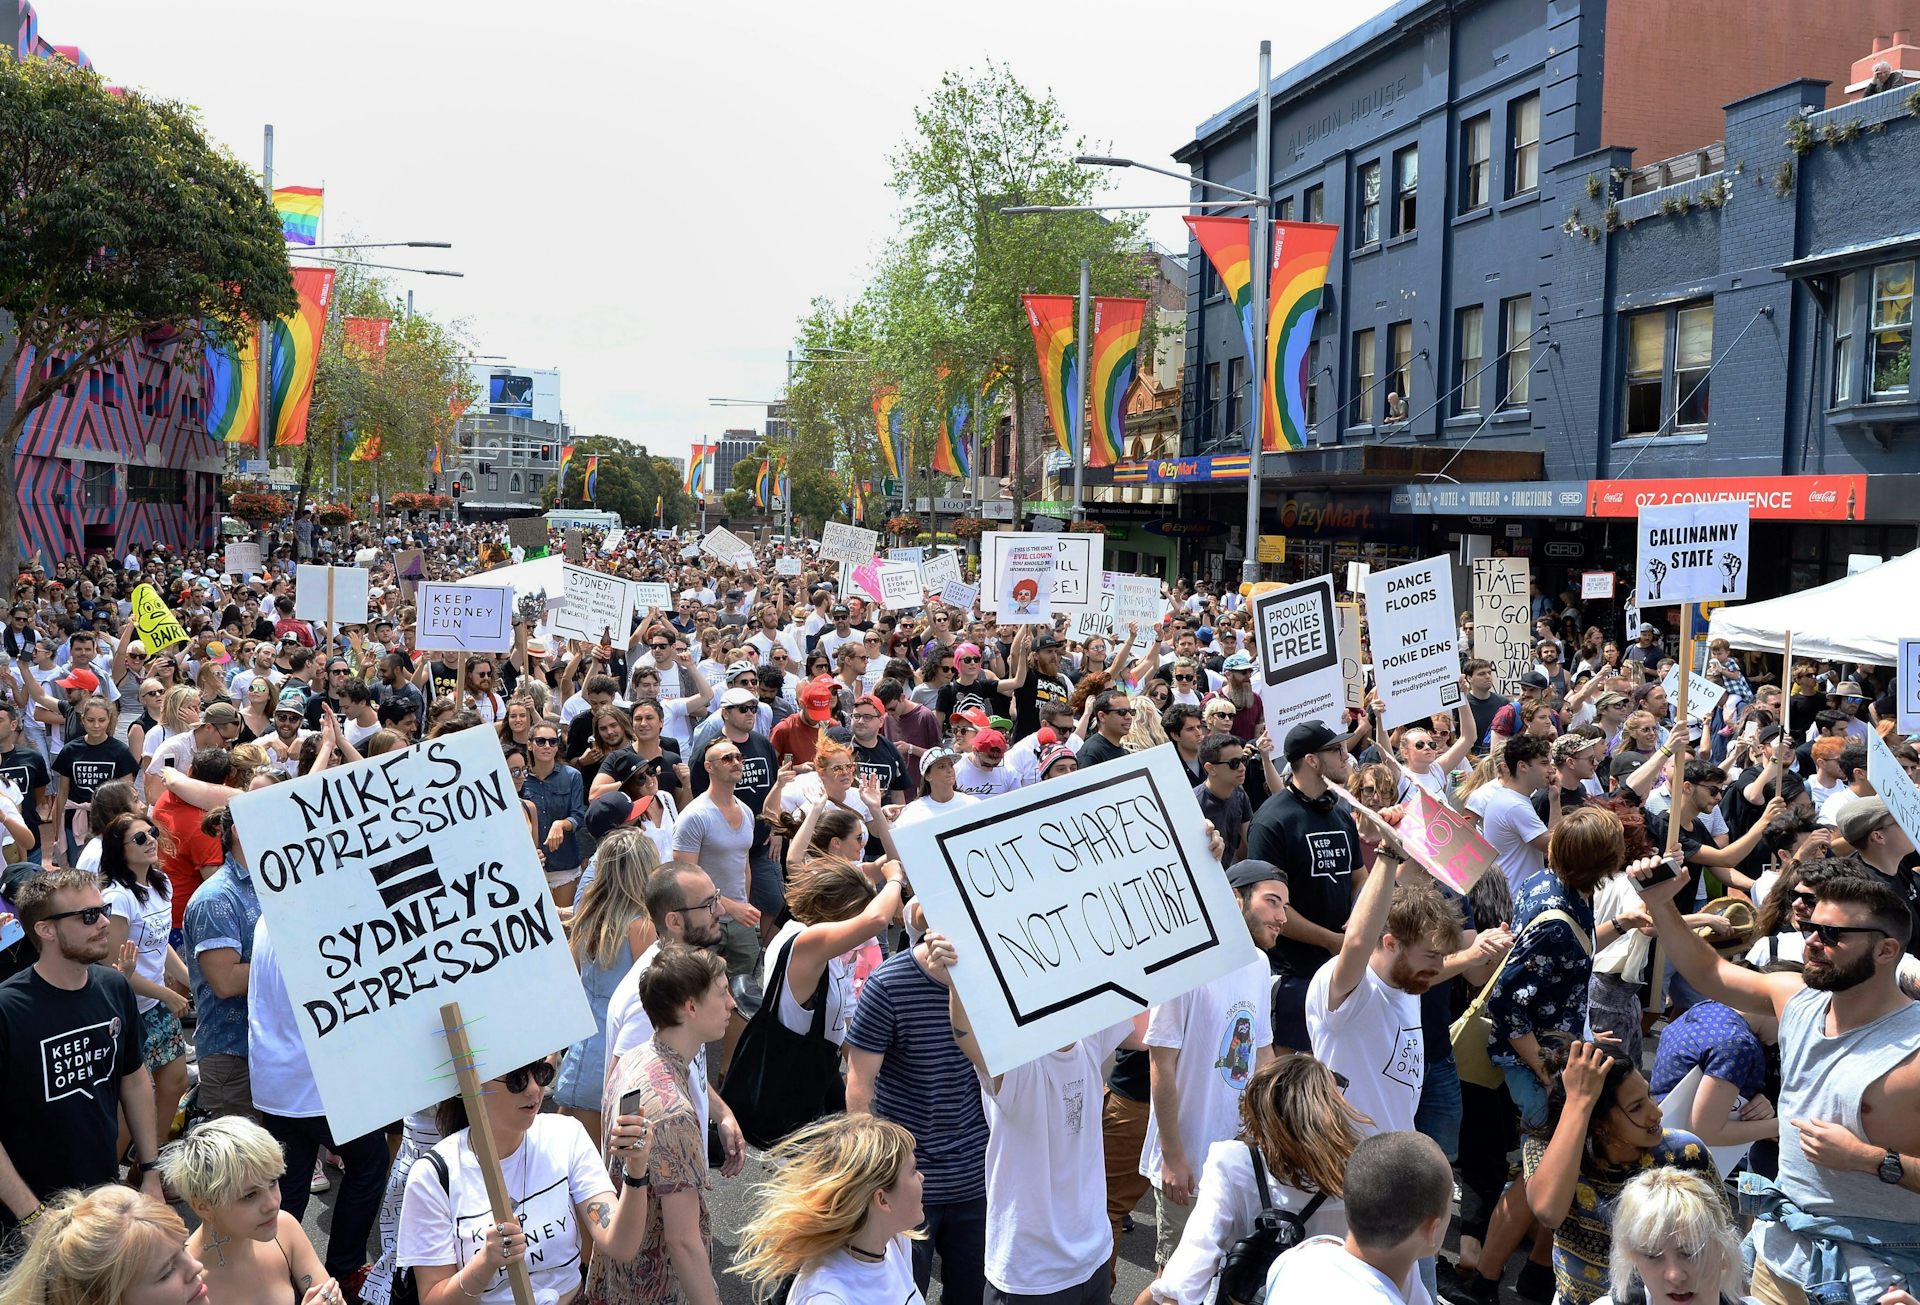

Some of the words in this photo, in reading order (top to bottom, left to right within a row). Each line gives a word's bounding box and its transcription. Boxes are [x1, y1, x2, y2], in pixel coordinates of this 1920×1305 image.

[1288, 108, 1341, 156] ALBION
[1351, 74, 1406, 125] HOUSE
[1165, 462, 1197, 480] EzyMart
[1439, 492, 1458, 506] HOTEL
[1469, 492, 1499, 506] WINEBAR
[1511, 491, 1552, 506] FUNCTIONS
[1659, 493, 1668, 505] 2
[1297, 502, 1372, 533] EzyMart
[824, 533, 874, 553] PRO-LOCKOUT
[826, 523, 848, 536] WHERE
[850, 529, 862, 539] ARE
[864, 531, 876, 541] THE
[1649, 523, 1738, 547] CALLINANNY
[822, 546, 872, 564] MARCHERS?
[1671, 549, 1714, 569] STATE
[571, 573, 612, 593] SYDNEY!
[1124, 584, 1144, 594] INVITED
[1145, 586, 1157, 596] MY
[1387, 571, 1432, 593] DANCE
[1474, 571, 1526, 594] TIME
[434, 594, 472, 604] KEEP
[565, 592, 590, 605] SPERANCE,
[947, 593, 961, 601] OPEN
[949, 589, 970, 600] SYDNEY
[1385, 589, 1437, 613] FLOORS
[1475, 594, 1501, 609] TO
[433, 606, 493, 617] SYDNEY
[1269, 598, 1317, 623] PROUDLY
[1501, 605, 1529, 624] GO
[432, 618, 462, 628] FUN
[1082, 612, 1114, 635] BAIR
[1270, 612, 1320, 640] POKIES
[1401, 628, 1428, 647] NOT
[1476, 625, 1508, 644] TO
[1272, 629, 1322, 664] FREE
[1382, 650, 1418, 670] POKIE
[1420, 640, 1452, 659] DENS
[1504, 641, 1530, 660] BED
[1392, 665, 1447, 687] #keepsydneyopen
[1490, 660, 1530, 679] ASINO
[1391, 674, 1451, 697] #proudlypokiesfree
[1674, 671, 1702, 691] Rht
[1703, 687, 1715, 698] to
[1277, 701, 1334, 726] #proudlypokiesfree
[1278, 692, 1332, 715] #keepsydneyopen
[743, 768, 766, 778] YDNEY
[290, 742, 463, 832] MIKE'S
[259, 769, 508, 892] OPPRESSION
[966, 835, 1035, 898] CUT
[1038, 795, 1170, 873] SHAPES
[1313, 839, 1331, 848] KEEP
[318, 861, 520, 980] SYDNEY'S
[997, 904, 1081, 977] NOT
[1081, 862, 1199, 956] CULTURE
[302, 892, 554, 1039] DEPRESSION
[52, 1036, 90, 1059] KEEP
[54, 1046, 111, 1074] SYDNEY
[55, 1064, 94, 1088] OPEN
